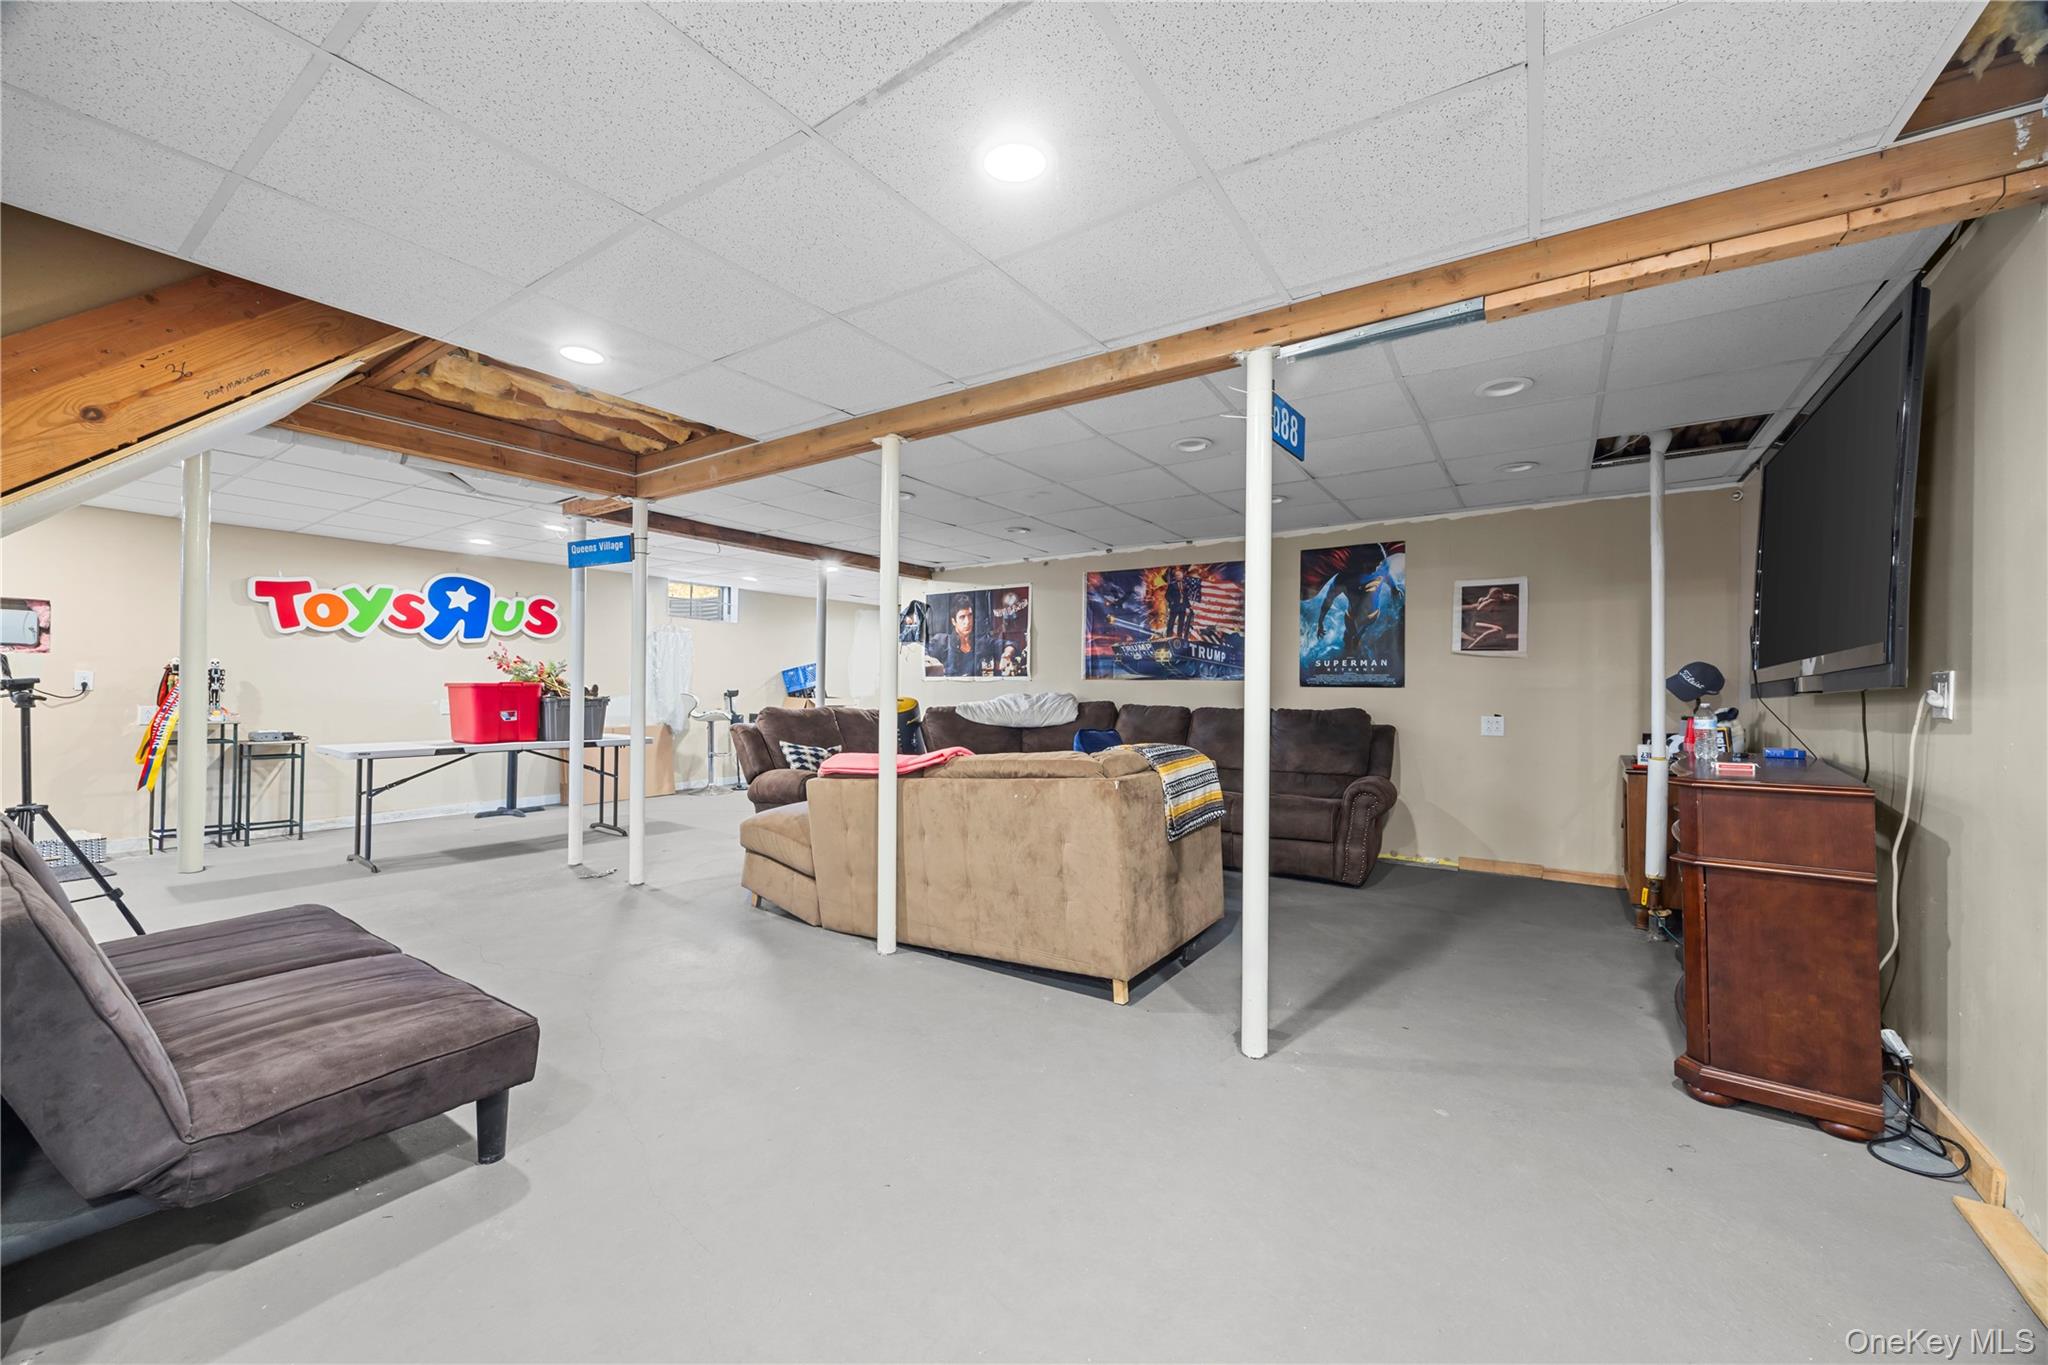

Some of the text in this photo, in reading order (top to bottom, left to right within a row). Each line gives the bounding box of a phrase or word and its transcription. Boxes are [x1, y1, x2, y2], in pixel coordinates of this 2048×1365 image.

[165, 361, 193, 381] 36
[571, 541, 624, 554] Queens Village
[1121, 643, 1153, 654] TRUMP
[1189, 643, 1227, 663] TRUMP
[1315, 659, 1388, 667] SUPERMAN
